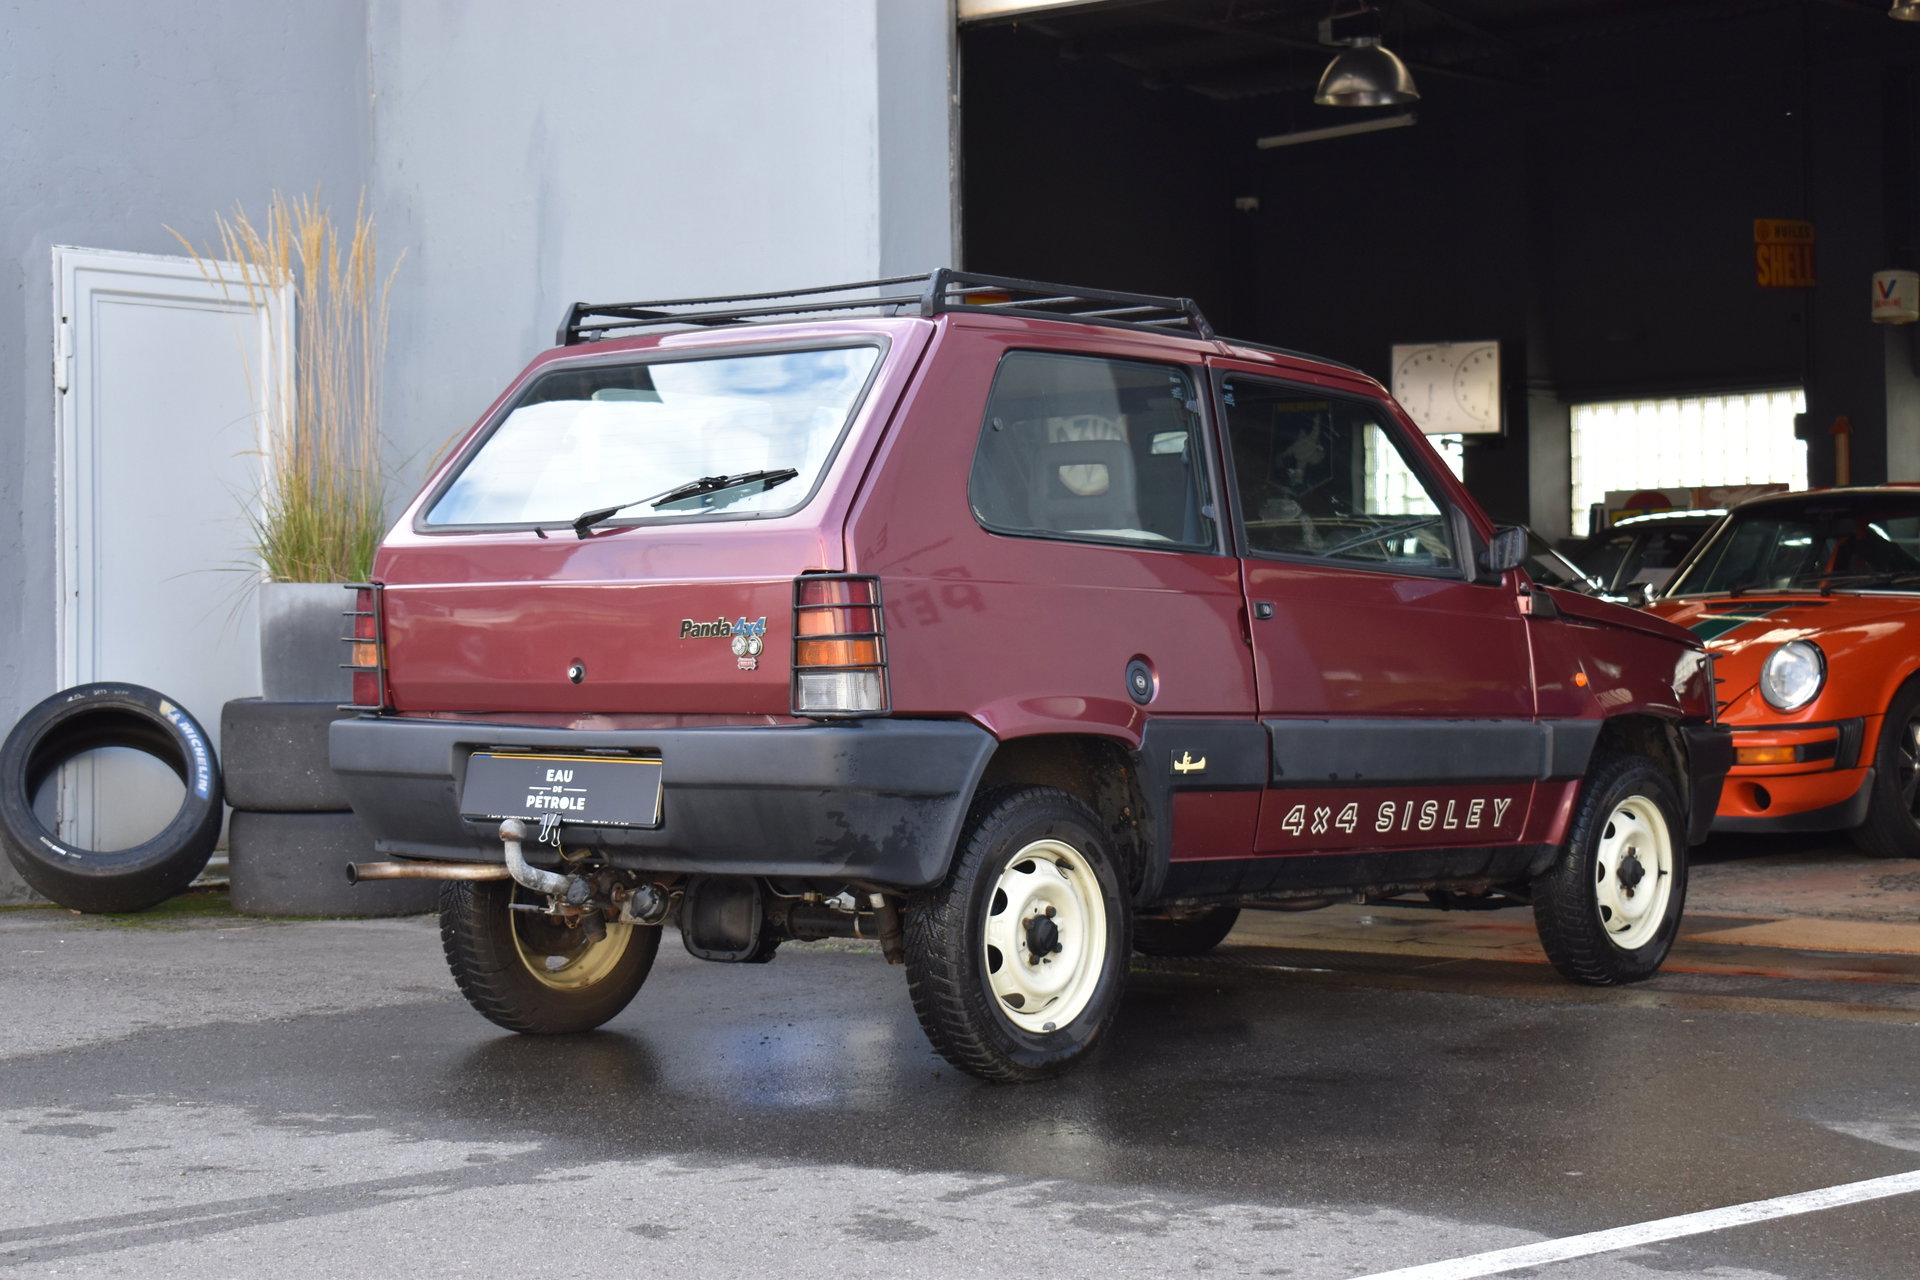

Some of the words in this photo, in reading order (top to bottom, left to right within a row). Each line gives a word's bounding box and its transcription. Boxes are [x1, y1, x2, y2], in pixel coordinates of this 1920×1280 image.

[1756, 244, 1816, 287] SHELL
[680, 617, 732, 639] Panda
[731, 616, 767, 637] 4x4
[178, 721, 209, 792] MICHELIN
[545, 768, 574, 783] EAU
[551, 785, 563, 793] DE
[525, 791, 586, 811] PÉTROLE
[1281, 803, 1359, 836] 4x4
[1375, 798, 1512, 833] SISLEY
